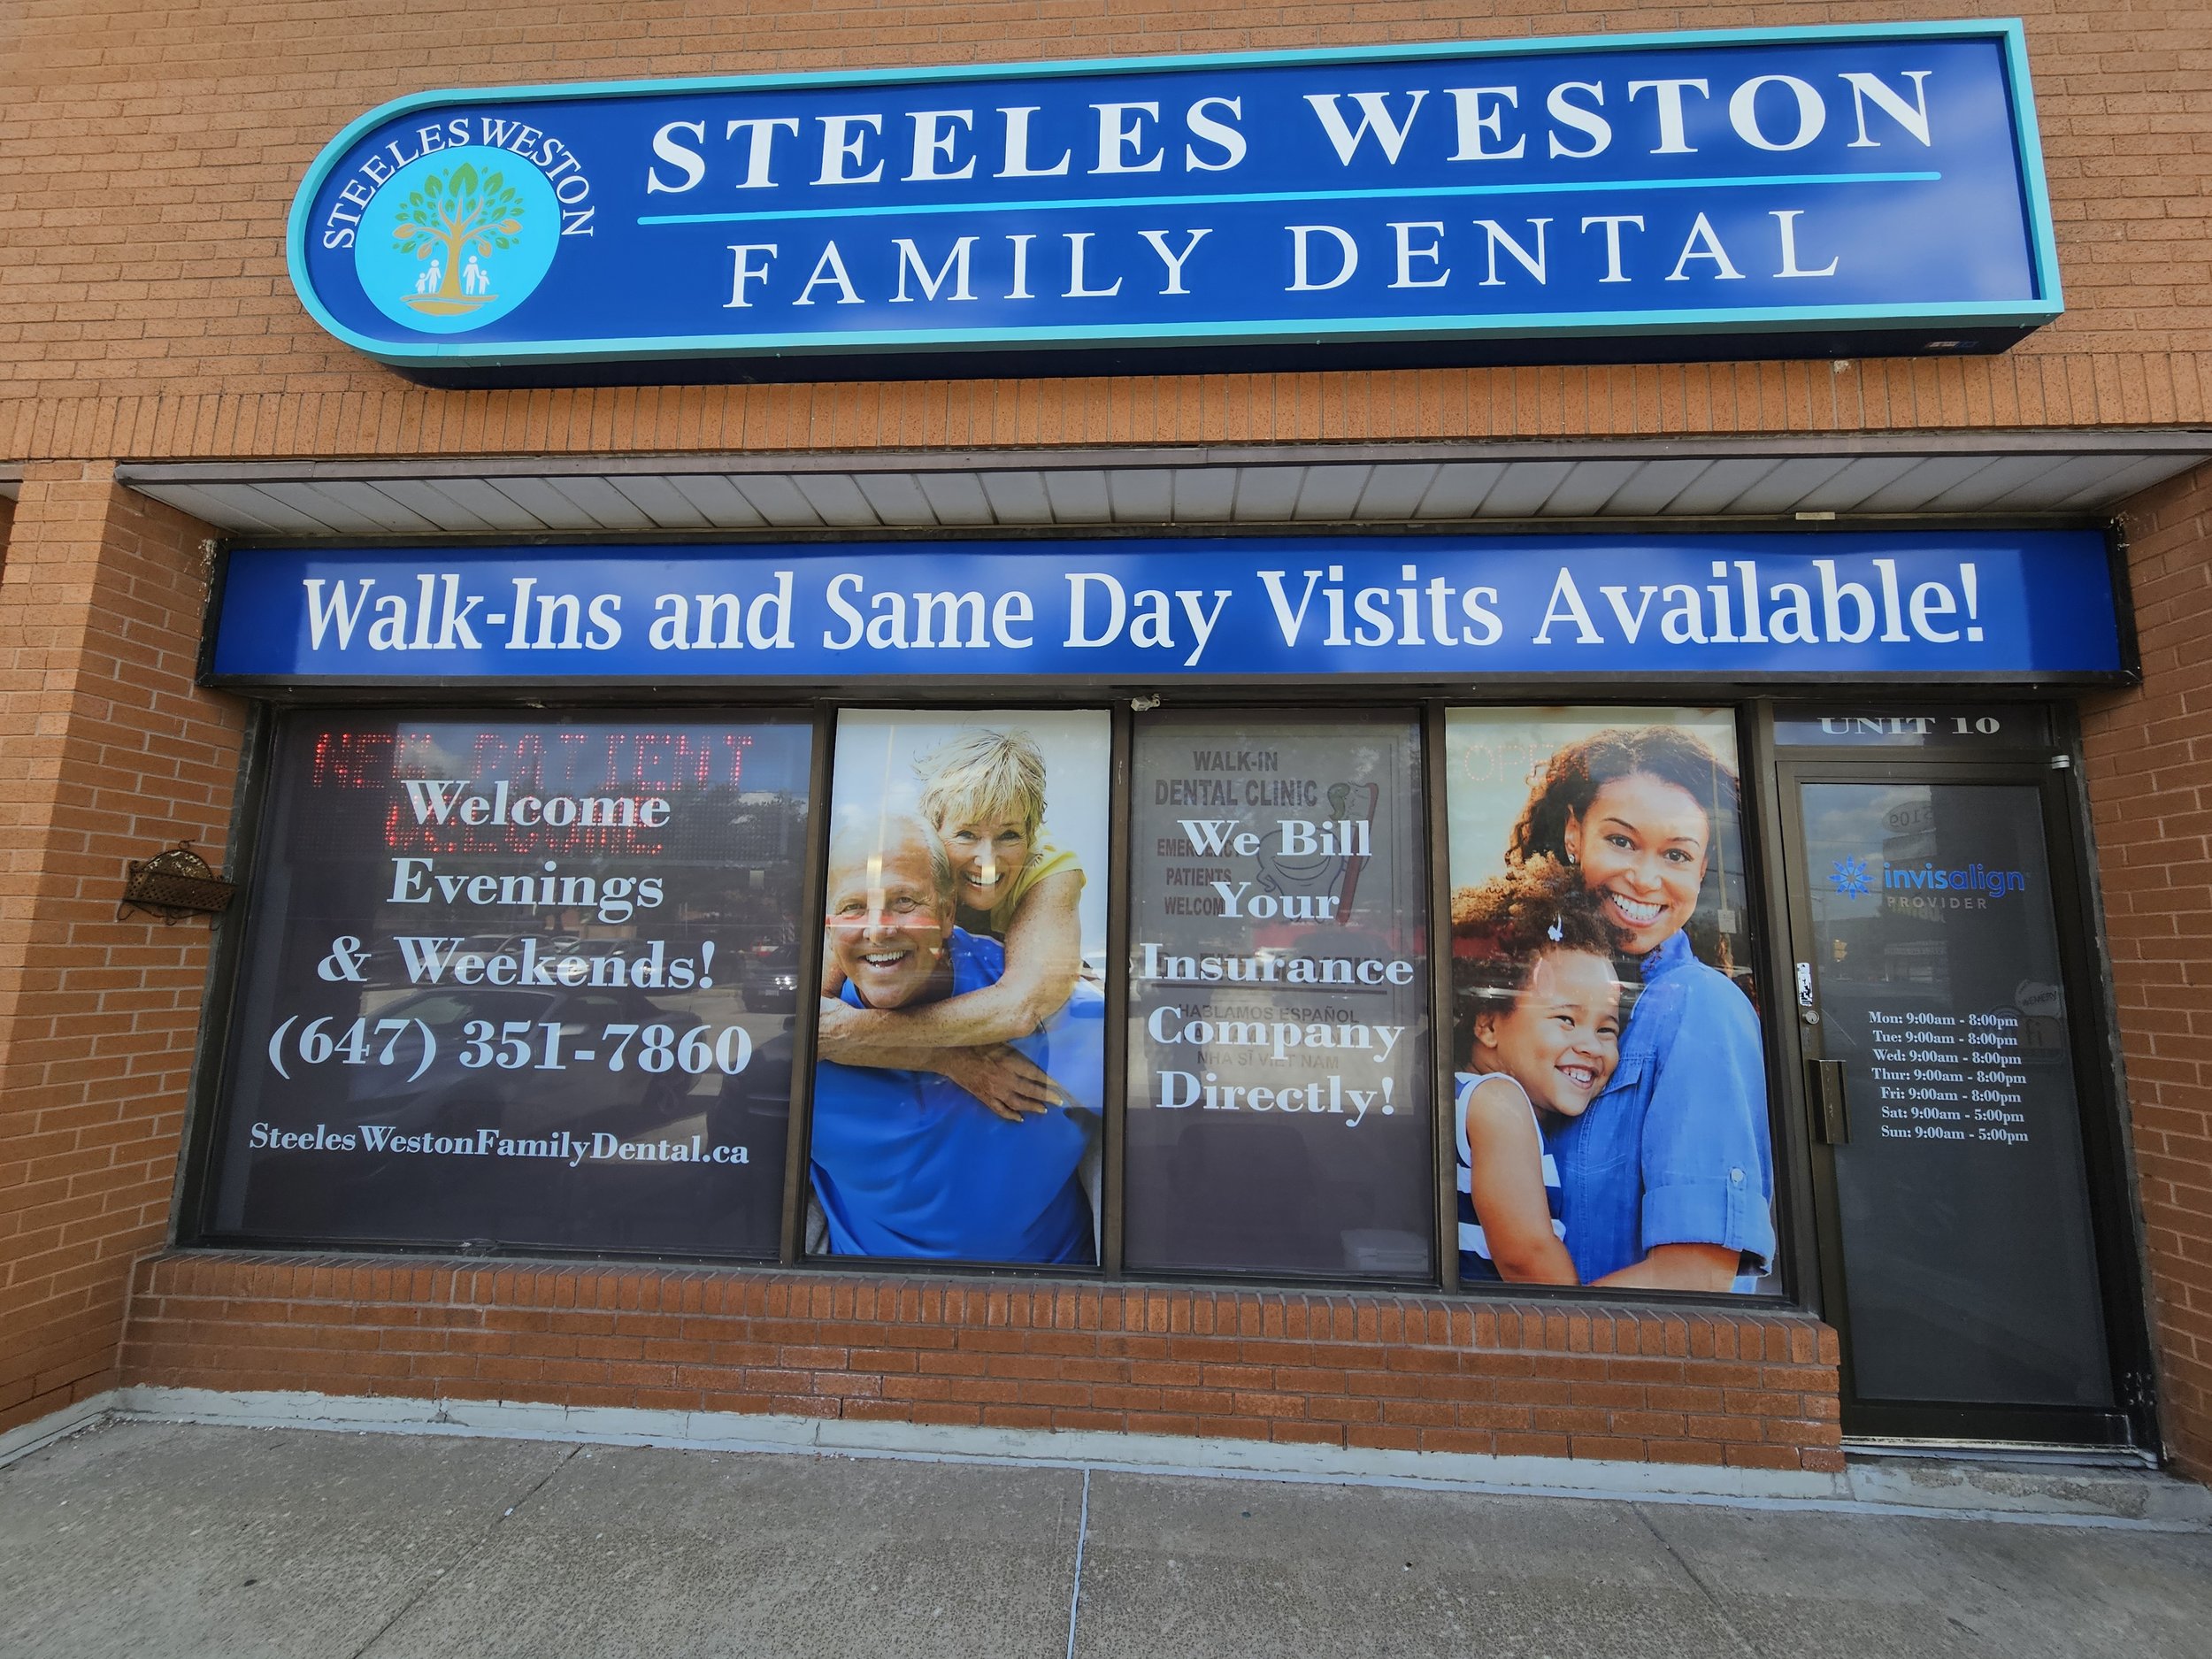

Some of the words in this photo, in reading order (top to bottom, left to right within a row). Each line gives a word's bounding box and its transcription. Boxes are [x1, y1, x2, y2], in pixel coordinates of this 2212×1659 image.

[648, 96, 1248, 195] STEELES
[1303, 71, 1933, 167] WESTON
[323, 118, 471, 250] STEELES
[480, 118, 595, 237] WESTON
[722, 228, 1214, 309] FAMILY
[1285, 210, 1839, 292] DENTAL
[303, 573, 623, 651] Walk-Ins
[649, 571, 795, 651] and
[822, 573, 1034, 651] Same
[1063, 572, 1233, 667] Day
[1257, 565, 1502, 648] Visits
[1532, 558, 1985, 645] Available!
[1816, 718, 1936, 735] UNIT
[1950, 718, 2001, 734] 10
[1194, 751, 1278, 772] WALK-IN
[401, 780, 671, 827] Welcome
[1155, 779, 1239, 806] DENTAL
[1245, 780, 1318, 807] CLINIC
[1177, 819, 1261, 857] We
[1277, 819, 1371, 856] Bill
[386, 857, 664, 924] Evenings
[1166, 867, 1232, 887] PATIENTS
[1884, 862, 2025, 898] invisalign
[1210, 881, 1340, 920] Your
[1886, 896, 1988, 910] PROVIDER
[317, 935, 373, 983] &
[393, 936, 715, 989] Weekends!
[1139, 942, 1414, 986] Insurance
[1148, 1005, 1405, 1064] Company
[1869, 1011, 1903, 1025] Mon:
[1906, 1012, 1955, 1025] 9:00am
[1969, 1014, 2018, 1030] 8:00pm
[1873, 1030, 1902, 1043] Tue:
[1905, 1031, 1955, 1044] 9:00am
[1968, 1033, 2018, 1048] 8:00pm
[268, 1015, 437, 1083] (647)
[458, 1020, 753, 1075] 351-7860
[1873, 1048, 1906, 1062] Wed:
[1909, 1050, 1959, 1063] 9:00am
[1972, 1052, 2022, 1068] 8:00pm
[1871, 1067, 1910, 1080] Thur:
[1914, 1069, 1963, 1082] 9:00am
[1977, 1071, 2027, 1087] 8:00pm
[1156, 1071, 1394, 1128] Directly!
[1880, 1087, 1905, 1100] Fri:
[1909, 1088, 1958, 1101] 9:00am
[1971, 1090, 2022, 1106] 8:00pm
[1882, 1106, 1908, 1119] Sat:
[1911, 1107, 1961, 1120] 9:00am
[1974, 1109, 2024, 1125] 5:00pm
[249, 1123, 749, 1168] SteelesWestonFamilyDental.ca
[1881, 1125, 1911, 1138] Sun:
[1915, 1126, 1965, 1140] 9:00am
[1978, 1128, 2029, 1145] 5:00pm
